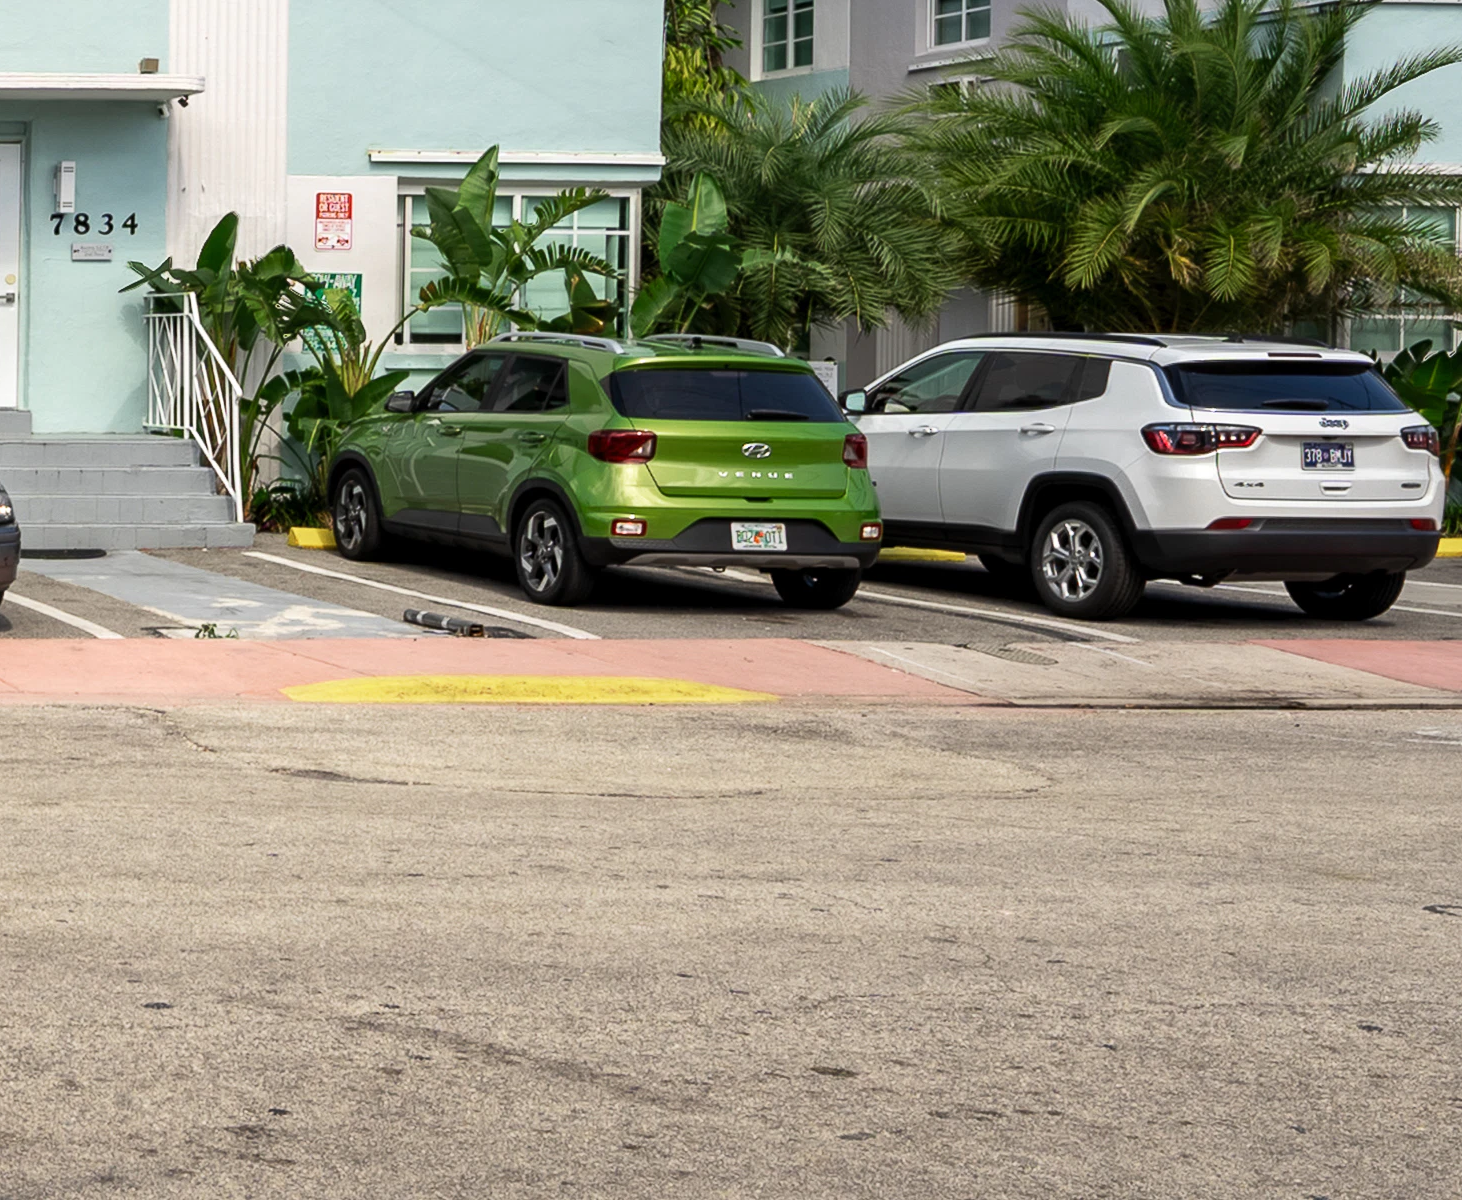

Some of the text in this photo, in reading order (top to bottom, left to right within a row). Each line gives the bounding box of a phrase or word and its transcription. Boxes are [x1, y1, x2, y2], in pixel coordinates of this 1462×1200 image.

[319, 203, 349, 211] OR GUEST
[50, 213, 138, 236] 7834
[1305, 449, 1322, 462] 378
